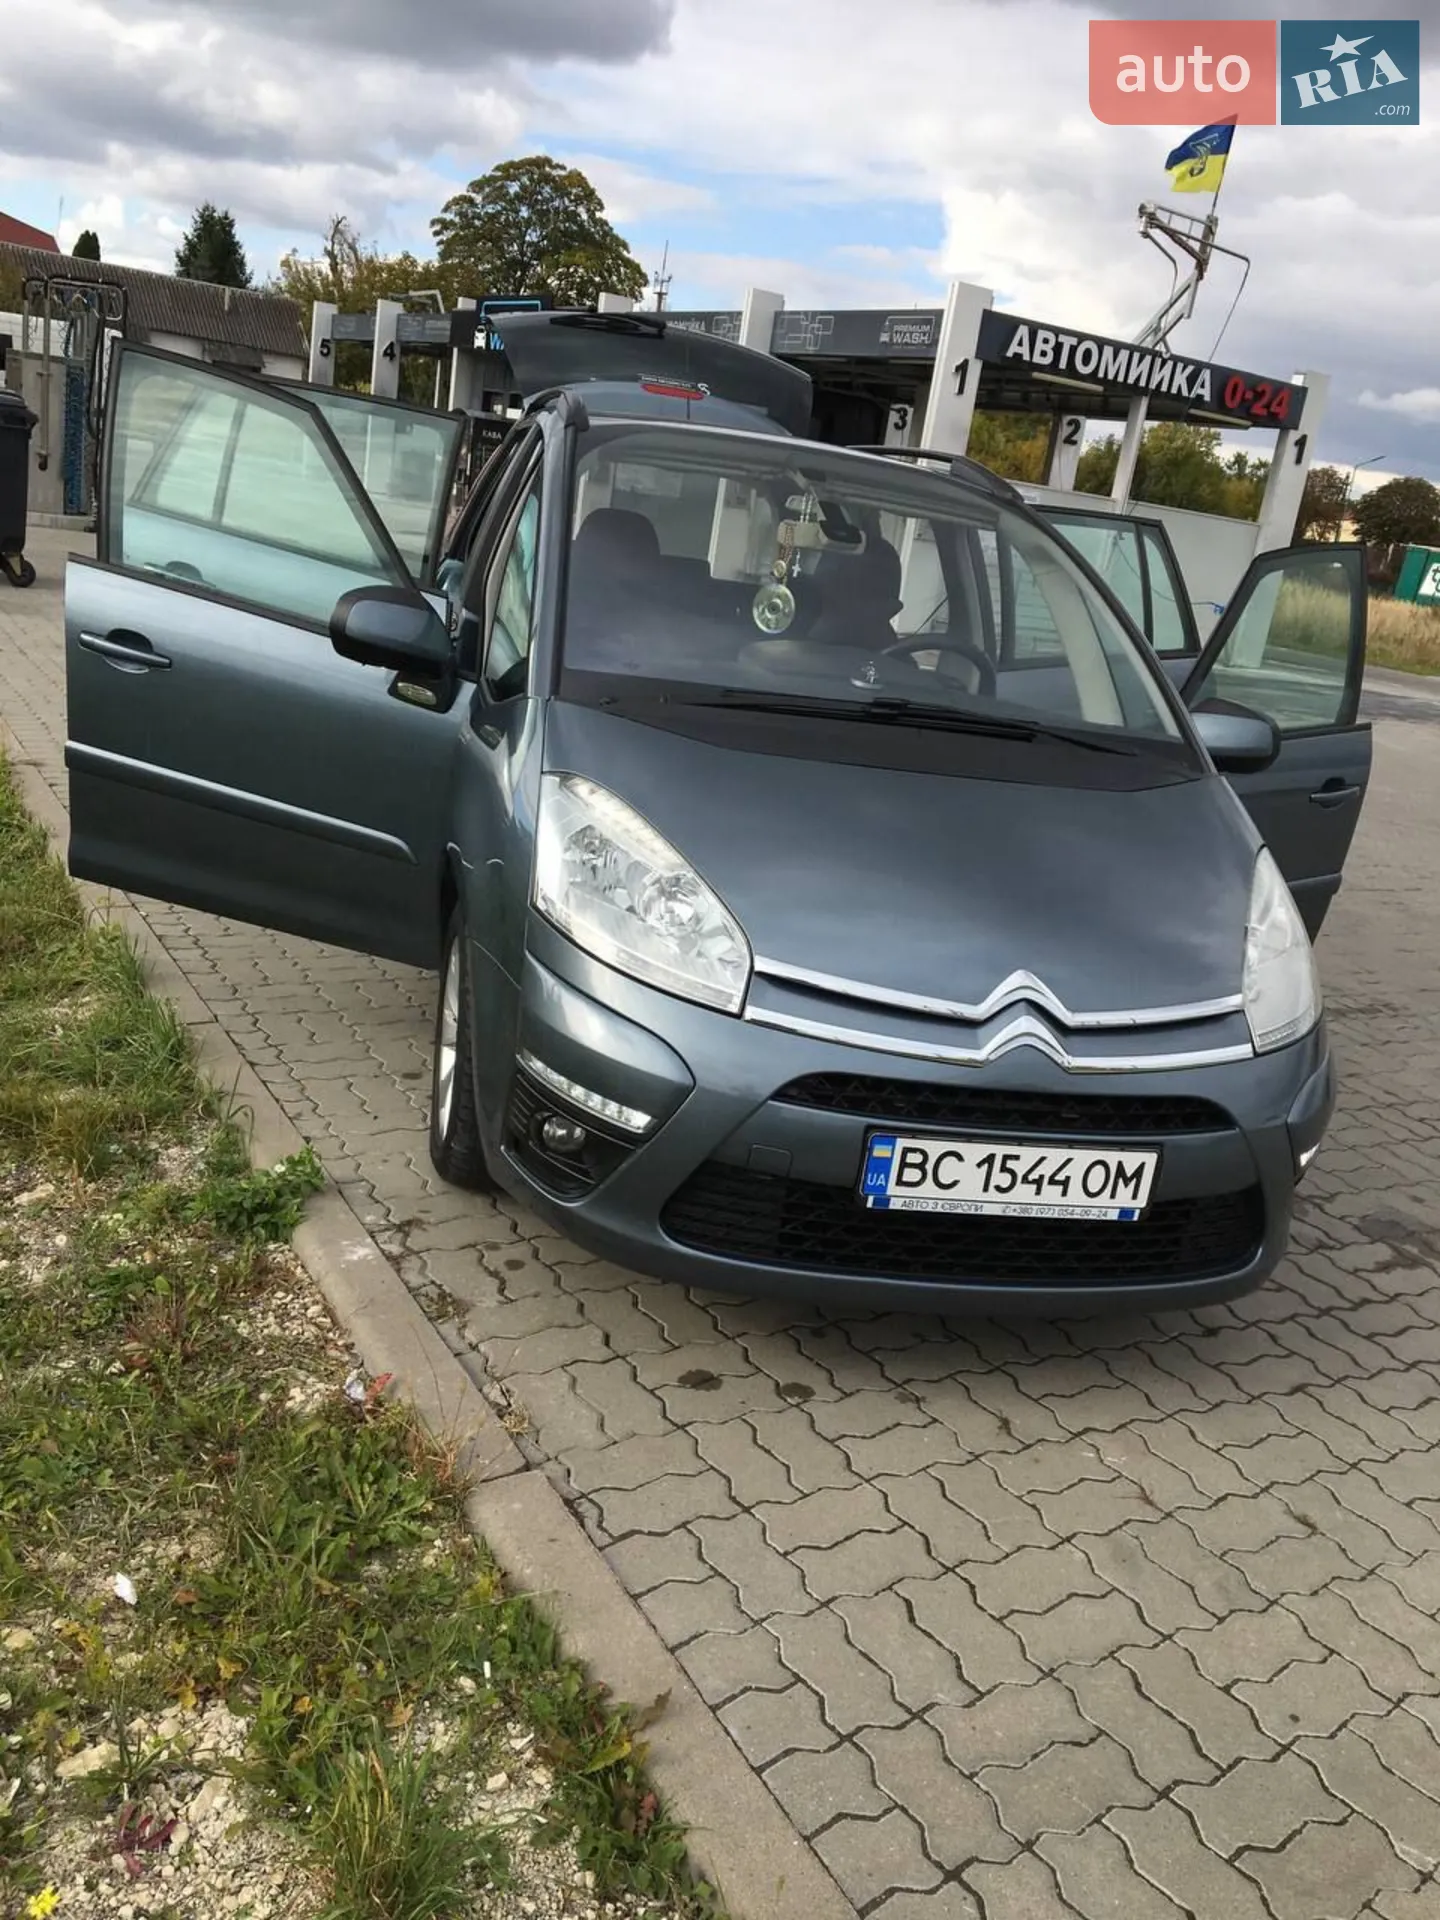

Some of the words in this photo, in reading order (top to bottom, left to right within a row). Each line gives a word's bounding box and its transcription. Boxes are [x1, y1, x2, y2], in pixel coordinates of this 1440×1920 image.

[892, 332, 930, 344] WASH
[893, 324, 931, 332] PREMIUM
[319, 338, 332, 357] 5
[382, 341, 397, 361] 4
[1005, 324, 1212, 403] АВТОМИЙКА
[954, 358, 969, 396] 1
[892, 406, 908, 431] 3
[1062, 418, 1082, 446] 2
[1294, 433, 1309, 466] 1
[866, 1172, 888, 1188] UA
[895, 1146, 965, 1190] BC
[975, 1152, 1075, 1198] 1544
[1081, 1158, 1147, 1200] OM
[900, 1200, 929, 1209] АВТО
